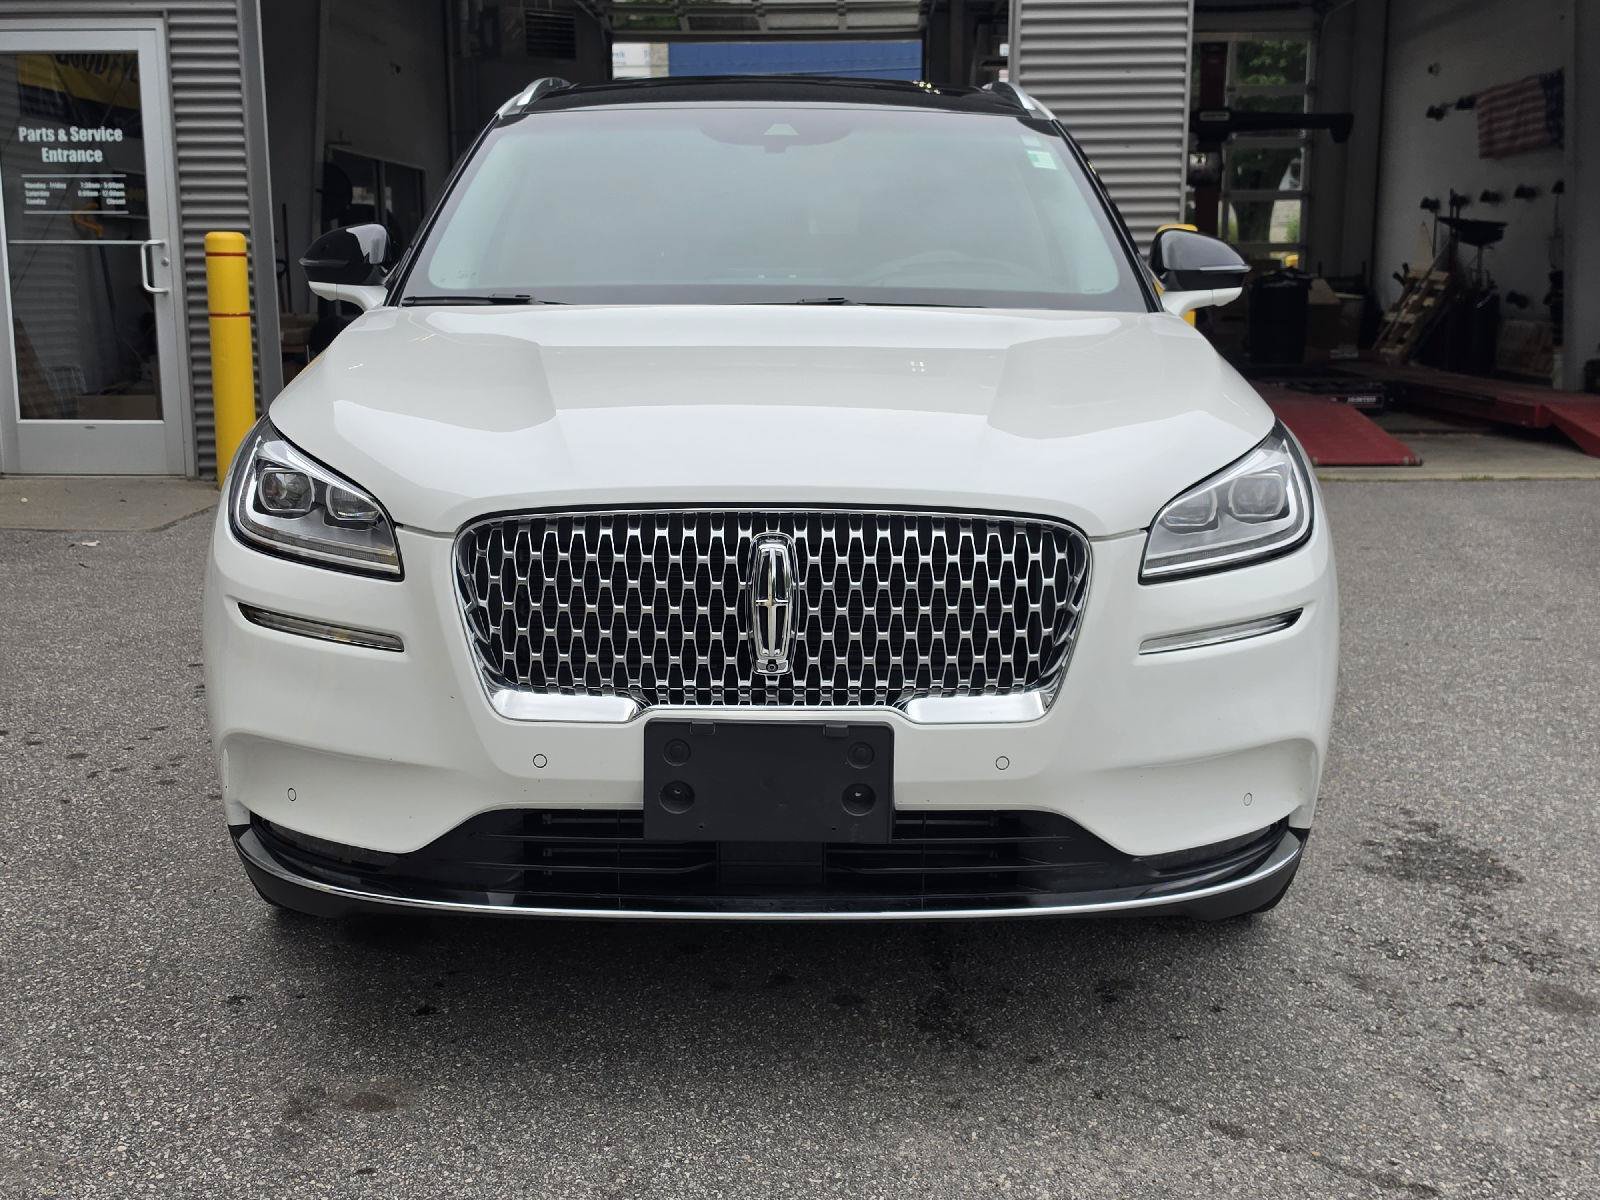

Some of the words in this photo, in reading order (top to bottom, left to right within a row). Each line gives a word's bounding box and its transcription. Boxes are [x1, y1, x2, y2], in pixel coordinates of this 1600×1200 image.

[18, 125, 55, 143] Parts
[57, 127, 68, 142] &
[69, 125, 123, 143] Service
[41, 146, 103, 163] Entrance
